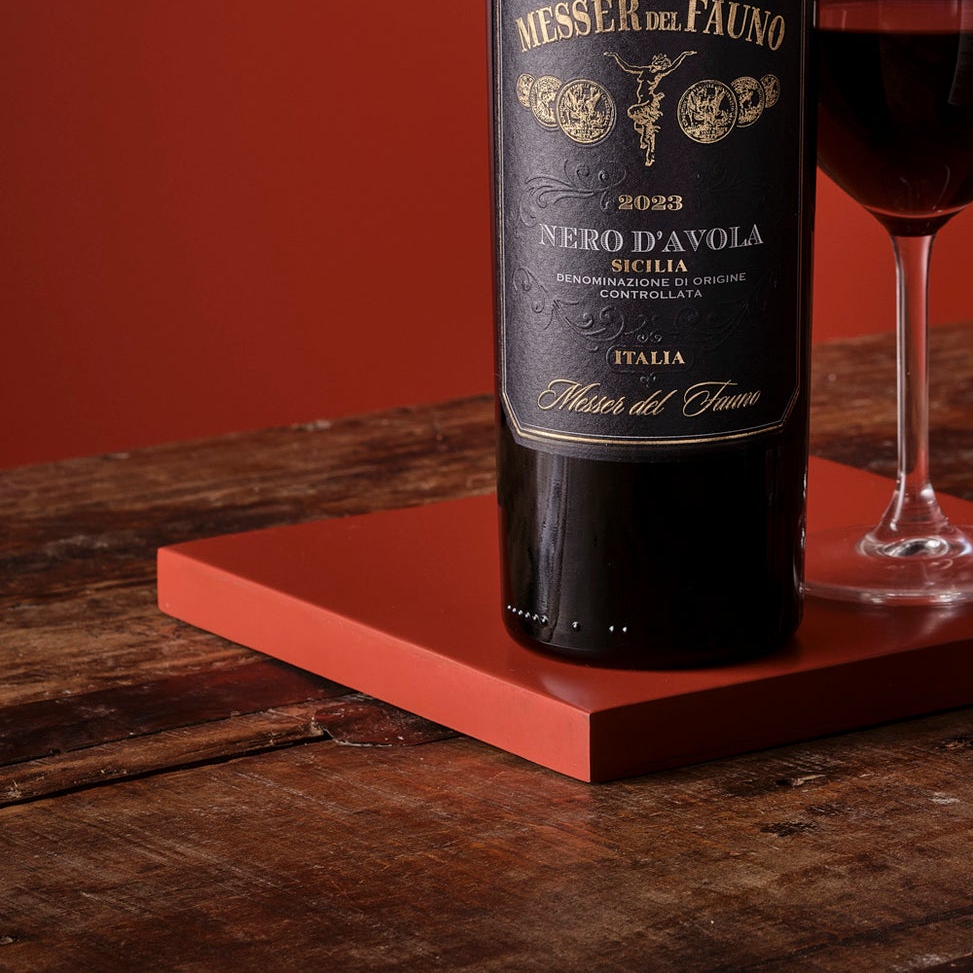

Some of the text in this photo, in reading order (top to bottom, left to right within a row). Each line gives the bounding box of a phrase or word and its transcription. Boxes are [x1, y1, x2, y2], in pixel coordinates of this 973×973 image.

[645, 10, 682, 32] DEL
[617, 194, 683, 211] 2023
[539, 223, 624, 253] NERO
[611, 258, 689, 274] SICILIA
[556, 272, 747, 288] DENOMINAZIONE DI ORIGINE
[599, 289, 703, 300] CONTROLLATA
[614, 350, 686, 366] ITALIA
[537, 378, 762, 418] Messer del Fauno
